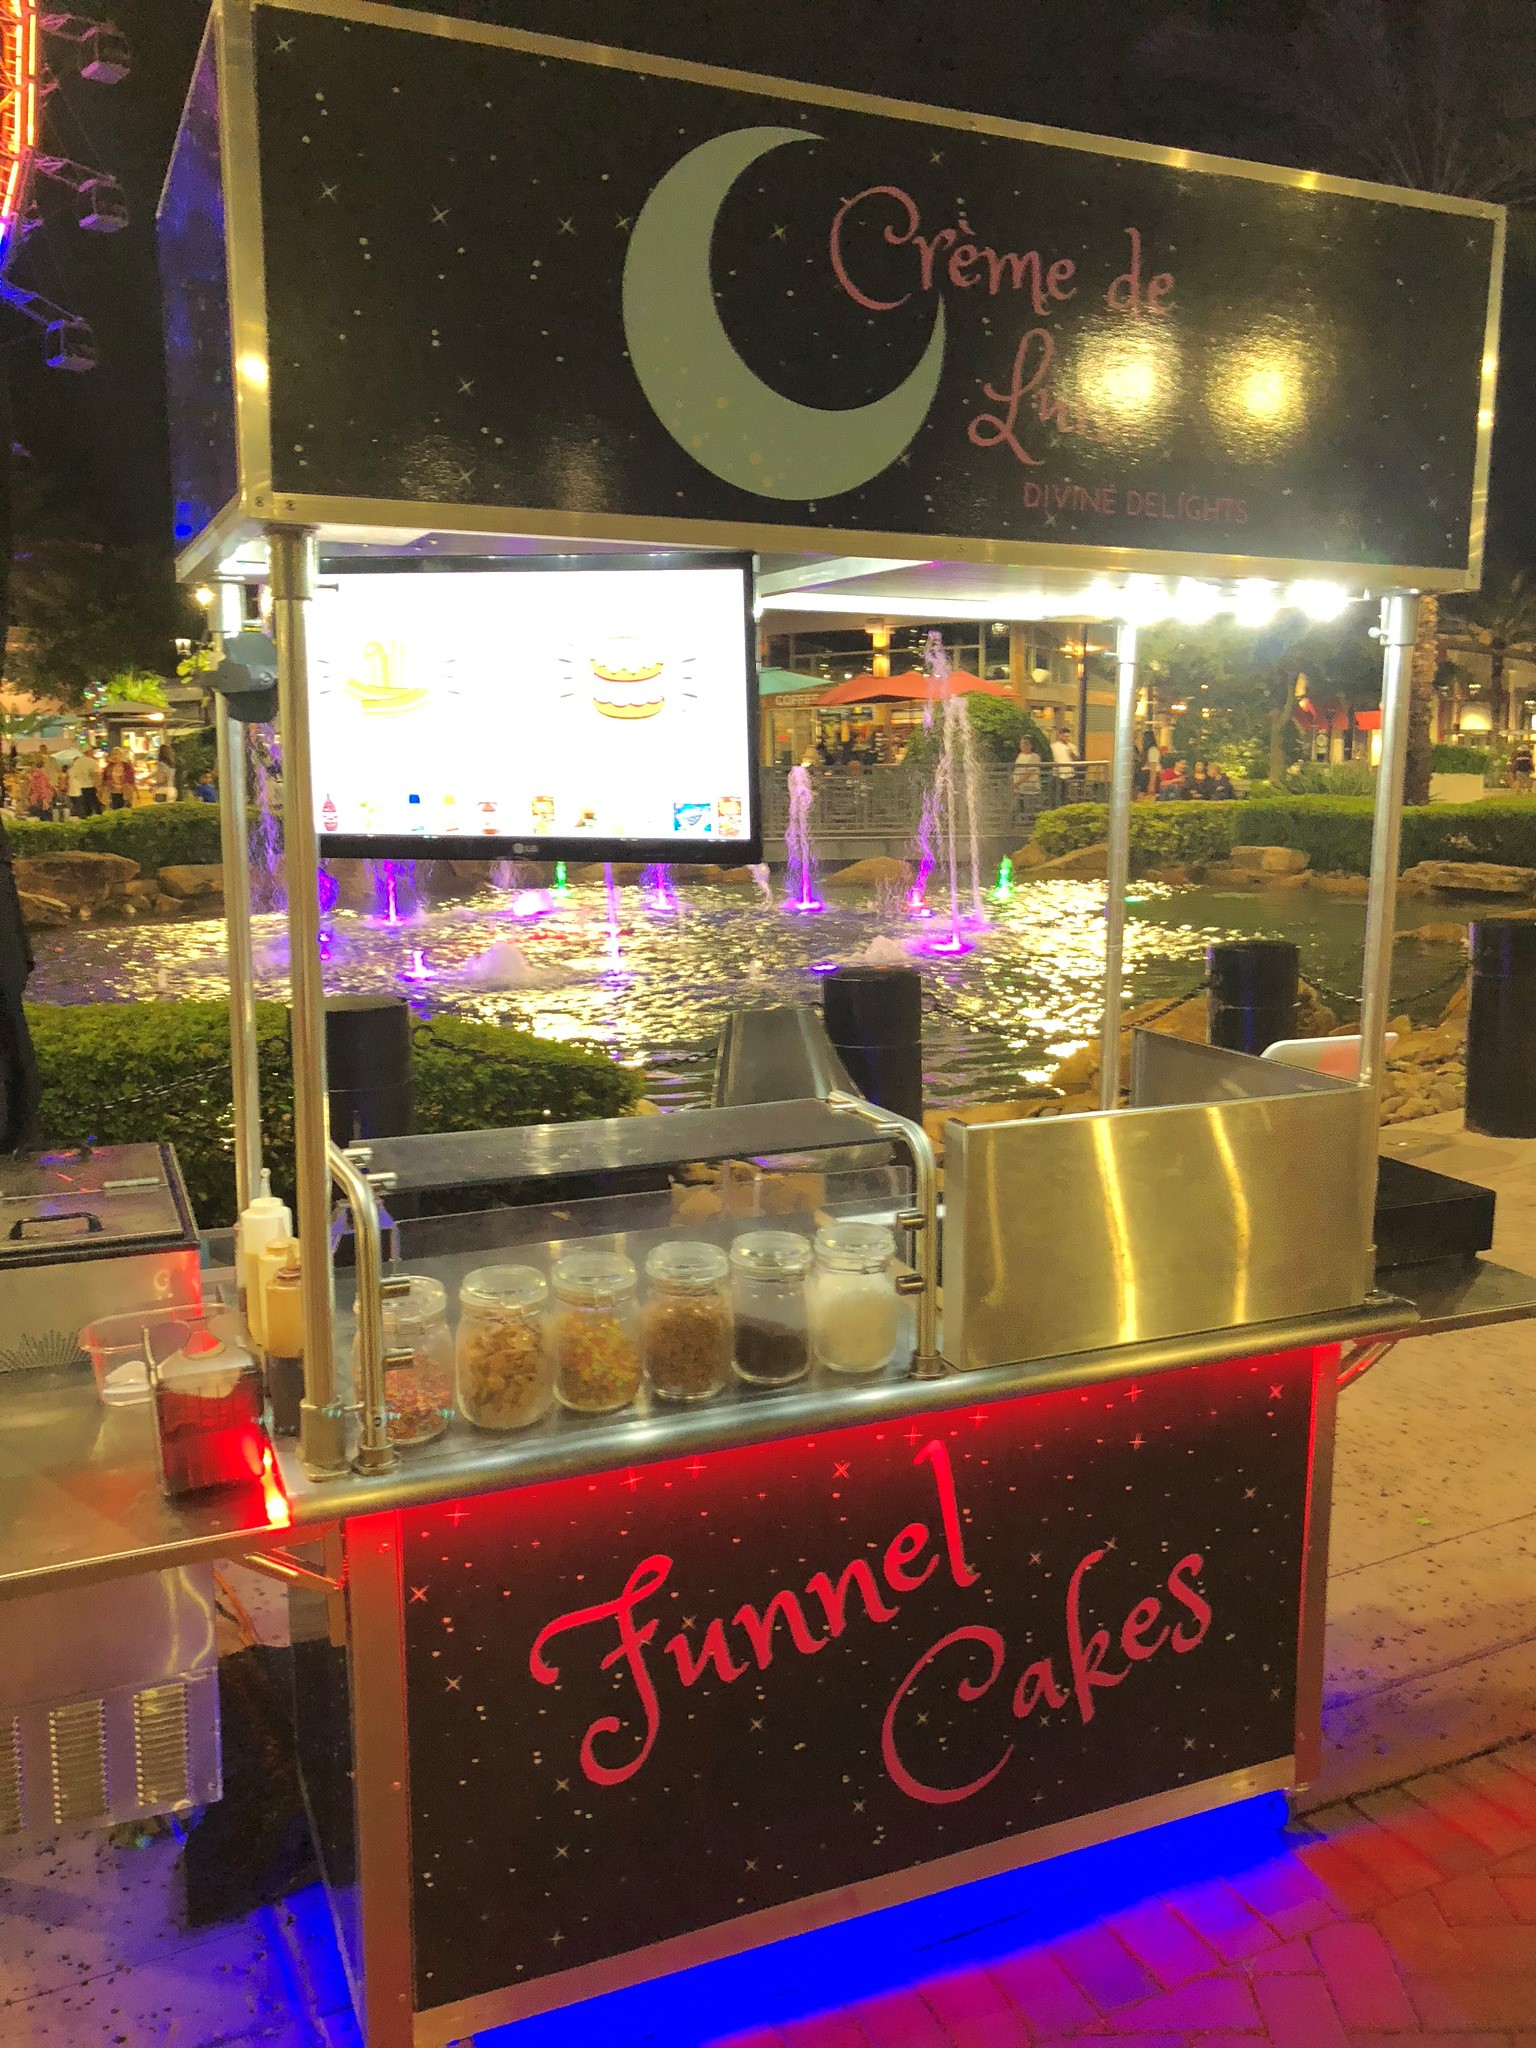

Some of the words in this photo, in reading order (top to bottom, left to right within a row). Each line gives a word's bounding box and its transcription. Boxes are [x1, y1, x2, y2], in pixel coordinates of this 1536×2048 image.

[829, 184, 1078, 317] Crème
[1106, 226, 1178, 317] de
[1022, 481, 1118, 516] DIVINE
[1125, 490, 1250, 525] DELIGHTS
[528, 1438, 981, 1786] Funnel
[880, 1549, 1213, 1805] Cakes
